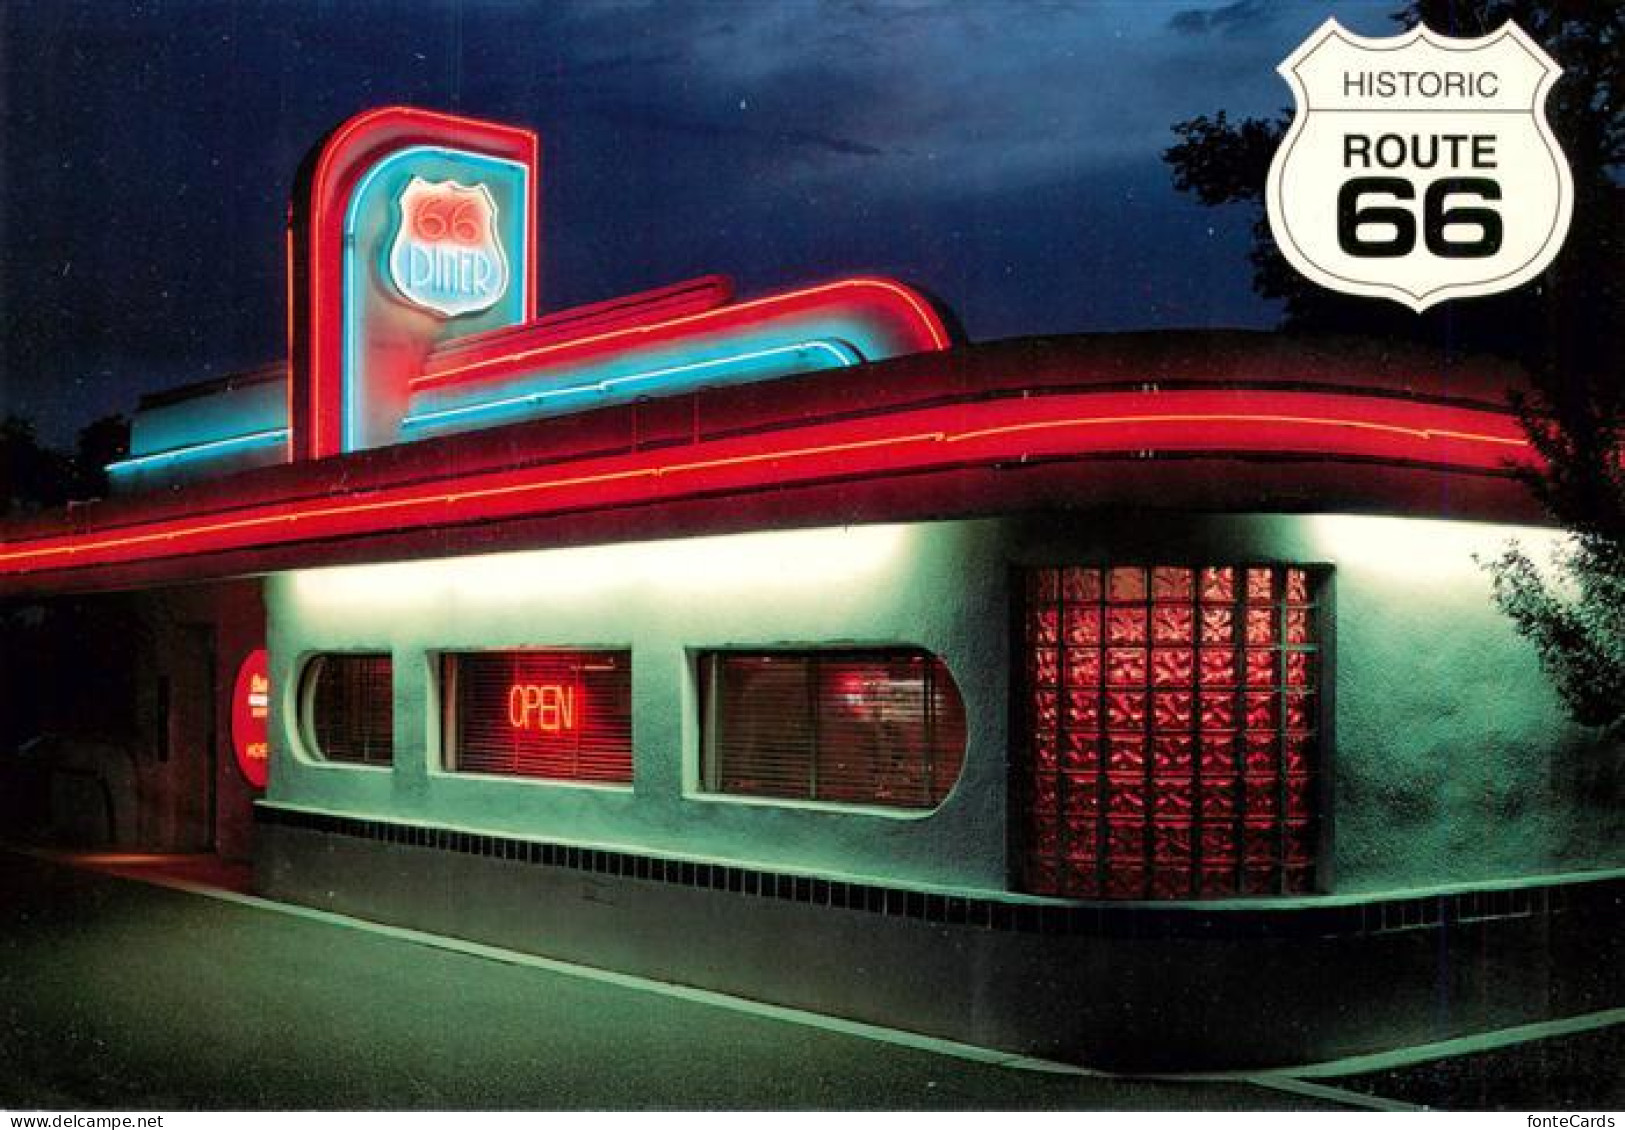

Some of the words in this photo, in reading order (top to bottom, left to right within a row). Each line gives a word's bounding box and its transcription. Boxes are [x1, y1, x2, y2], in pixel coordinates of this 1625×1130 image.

[416, 198, 484, 243] 66
[410, 243, 492, 296] DINER
[510, 685, 573, 730] OPEN
